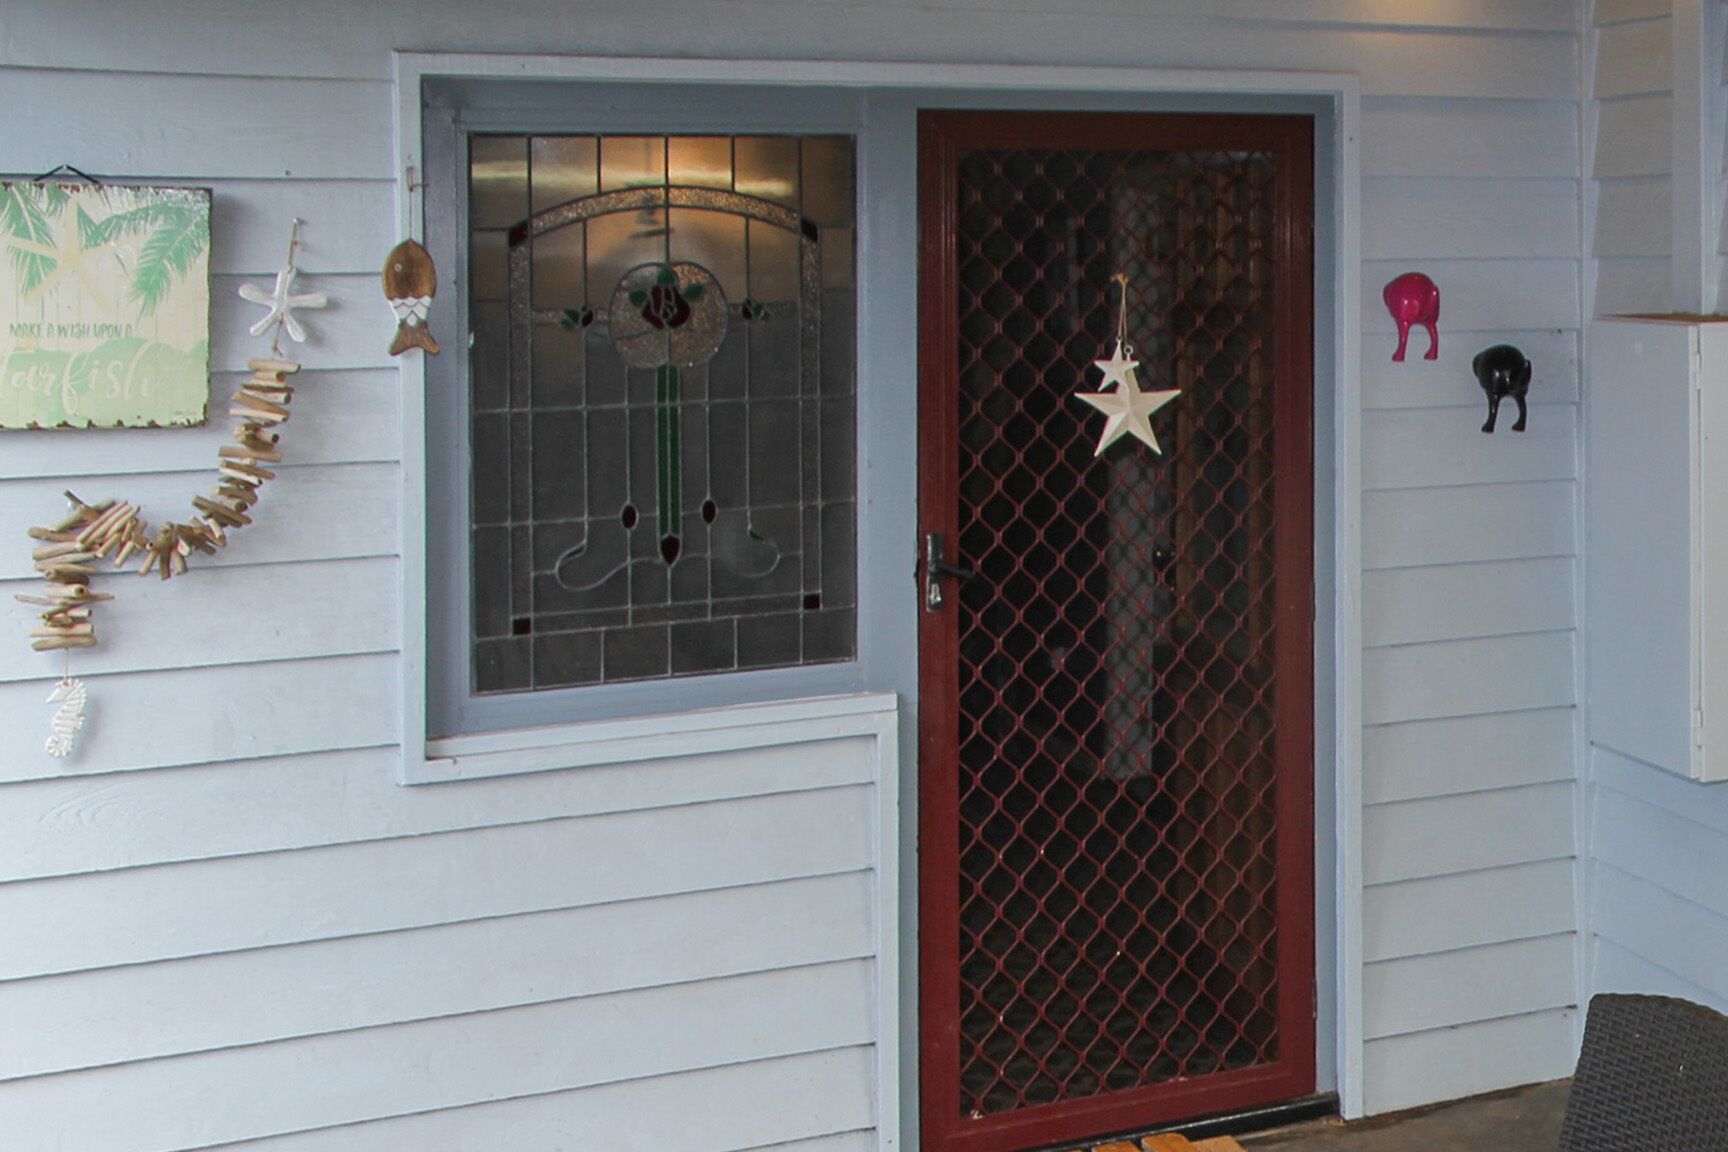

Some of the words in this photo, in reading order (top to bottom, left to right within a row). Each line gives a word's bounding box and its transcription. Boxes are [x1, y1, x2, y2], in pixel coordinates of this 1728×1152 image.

[9, 322, 41, 338] MAKE
[46, 322, 55, 338] A
[57, 322, 90, 338] WISH
[93, 322, 122, 338] UPON
